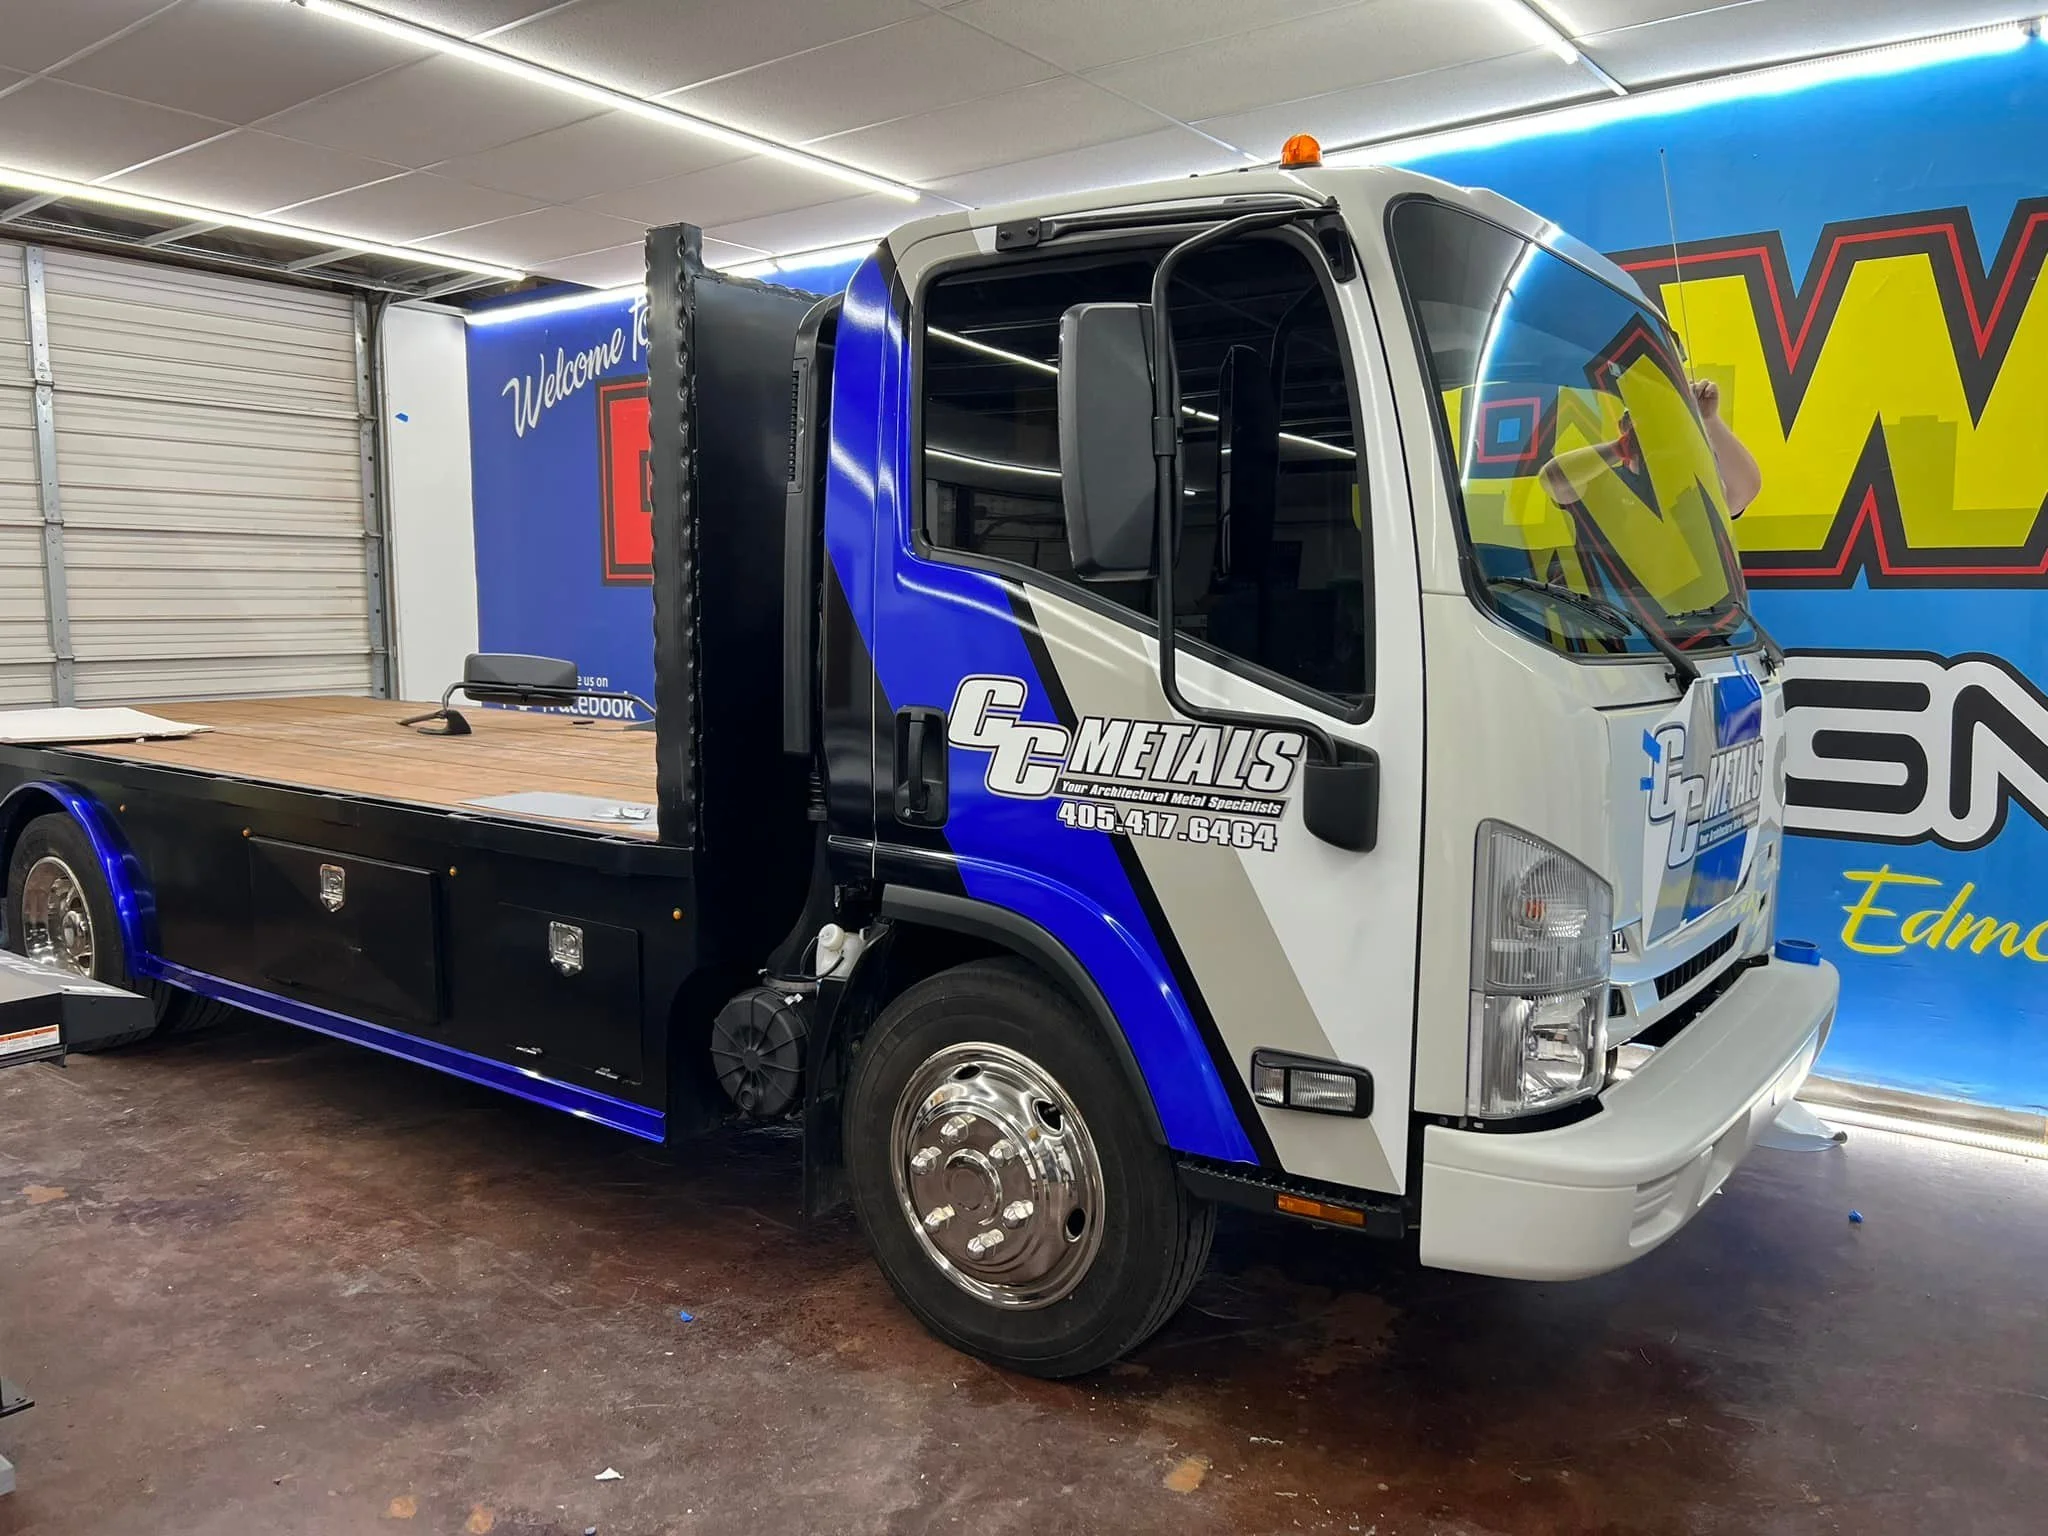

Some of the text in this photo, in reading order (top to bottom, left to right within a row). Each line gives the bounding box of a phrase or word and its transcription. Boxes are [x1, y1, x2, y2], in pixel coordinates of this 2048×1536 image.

[501, 327, 626, 438] Welcome
[583, 676, 595, 687] us
[596, 677, 608, 687] on
[1065, 716, 1305, 793] METALS
[1702, 738, 1764, 823] METALS
[1056, 800, 1278, 852] 405.417.6464
[1061, 780, 1282, 815] Your Architectural Metal Specialists
